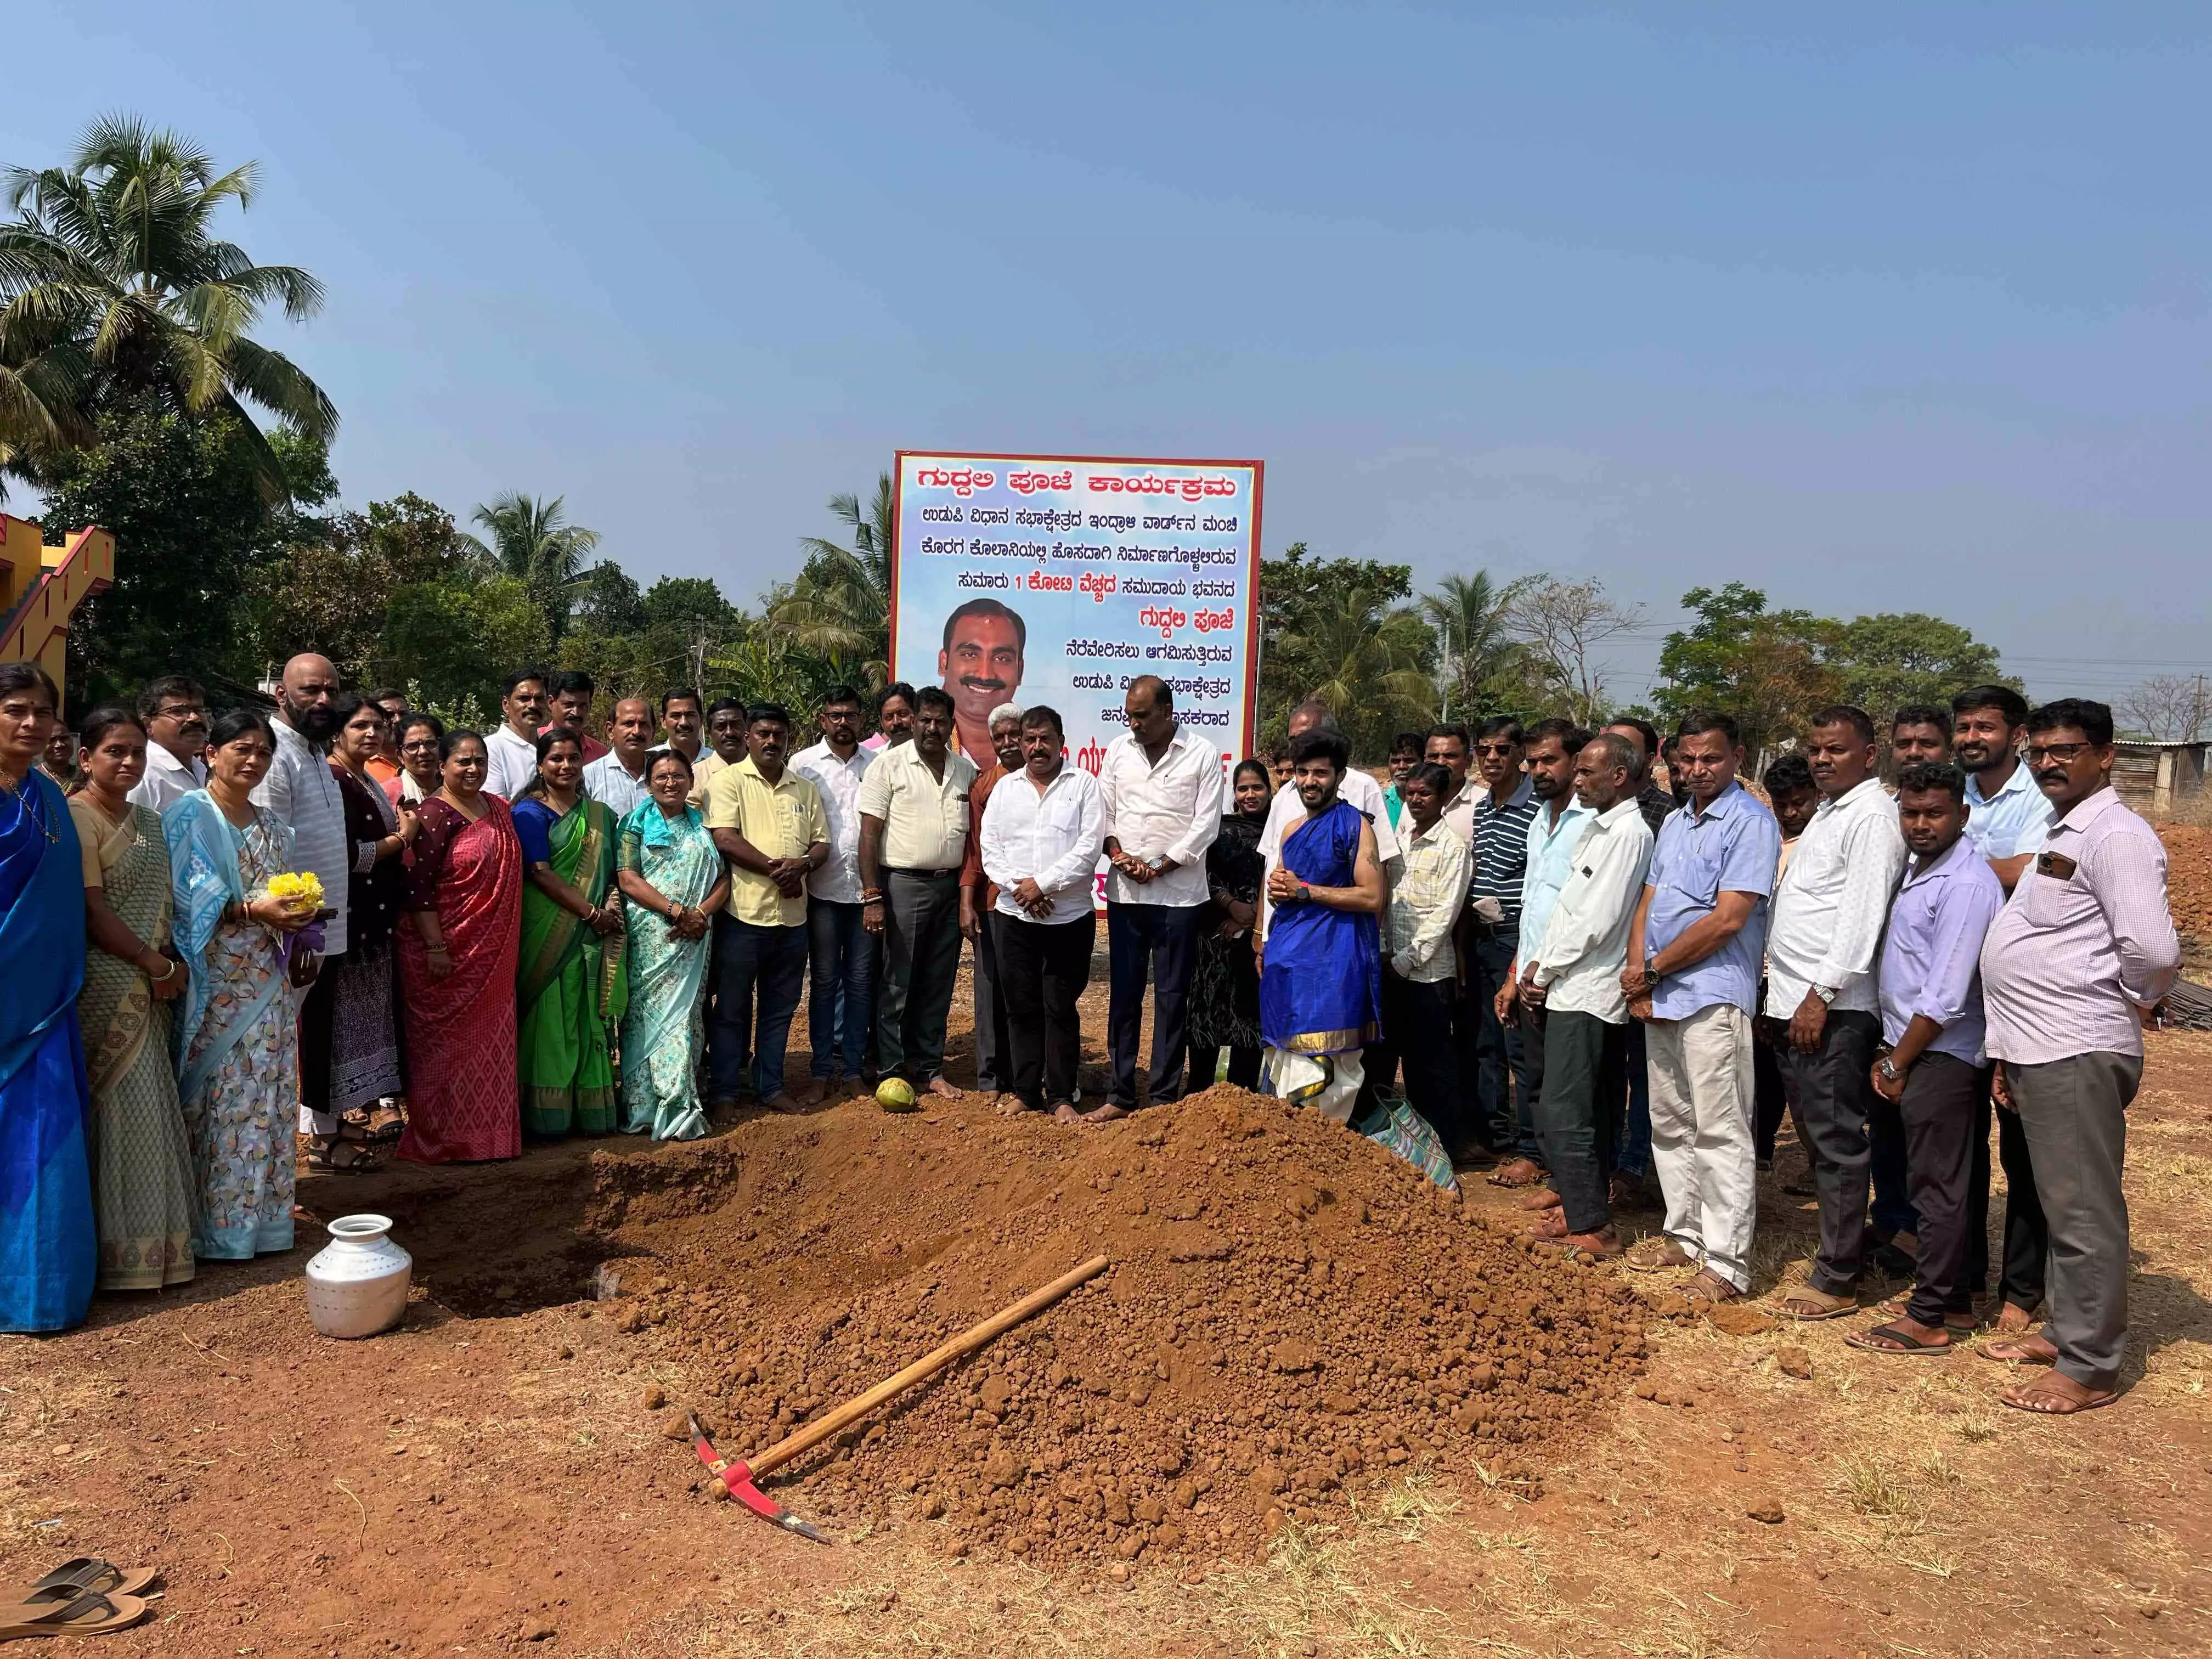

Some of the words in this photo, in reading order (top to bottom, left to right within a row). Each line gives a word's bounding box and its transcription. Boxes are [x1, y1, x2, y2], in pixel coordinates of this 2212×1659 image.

[918, 469, 994, 496] ಗುದ್ದಲಿ
[1009, 471, 1072, 494] ಪೂಜೆ
[1088, 475, 1235, 501] ಕಾರ್ಯಕ್ರಮ
[923, 505, 963, 522] ಉಡುಪಿ
[970, 507, 1009, 526] ವಿಧಾನ
[1015, 509, 1082, 534] ಸಭಾಕ್ಷೇತ್ರದ
[1088, 515, 1136, 533] ಇಂದ್ರಾಳಿ
[1203, 515, 1238, 532] ಮಂಚಿ
[922, 537, 964, 554] ಕೊರಗ
[969, 538, 1046, 564] ಕೊಲಾನಿಯಲ್ಲಿ
[1052, 541, 1111, 560] ಹೊಸದಾಗಿ
[958, 571, 1009, 589] ಸುಮಾರು
[1015, 576, 1020, 588] 1
[1028, 571, 1072, 591] ಕೋಟಿ
[1080, 573, 1116, 602] ವೆಚ್ಚದ
[1122, 577, 1186, 595] ಸಮುದಾಯ
[1192, 580, 1235, 599] ಭವನದ
[1140, 605, 1186, 638] ಗುದ್ದಲಿ
[1194, 608, 1234, 633] ಪೂಜೆ
[1066, 639, 1139, 658] ನೆರೆವೇರಿಸಲು
[1146, 643, 1232, 667] ಆಗಮಿಸುತ್ತಿರುವ
[1073, 673, 1113, 690] ಉಡುಪಿ
